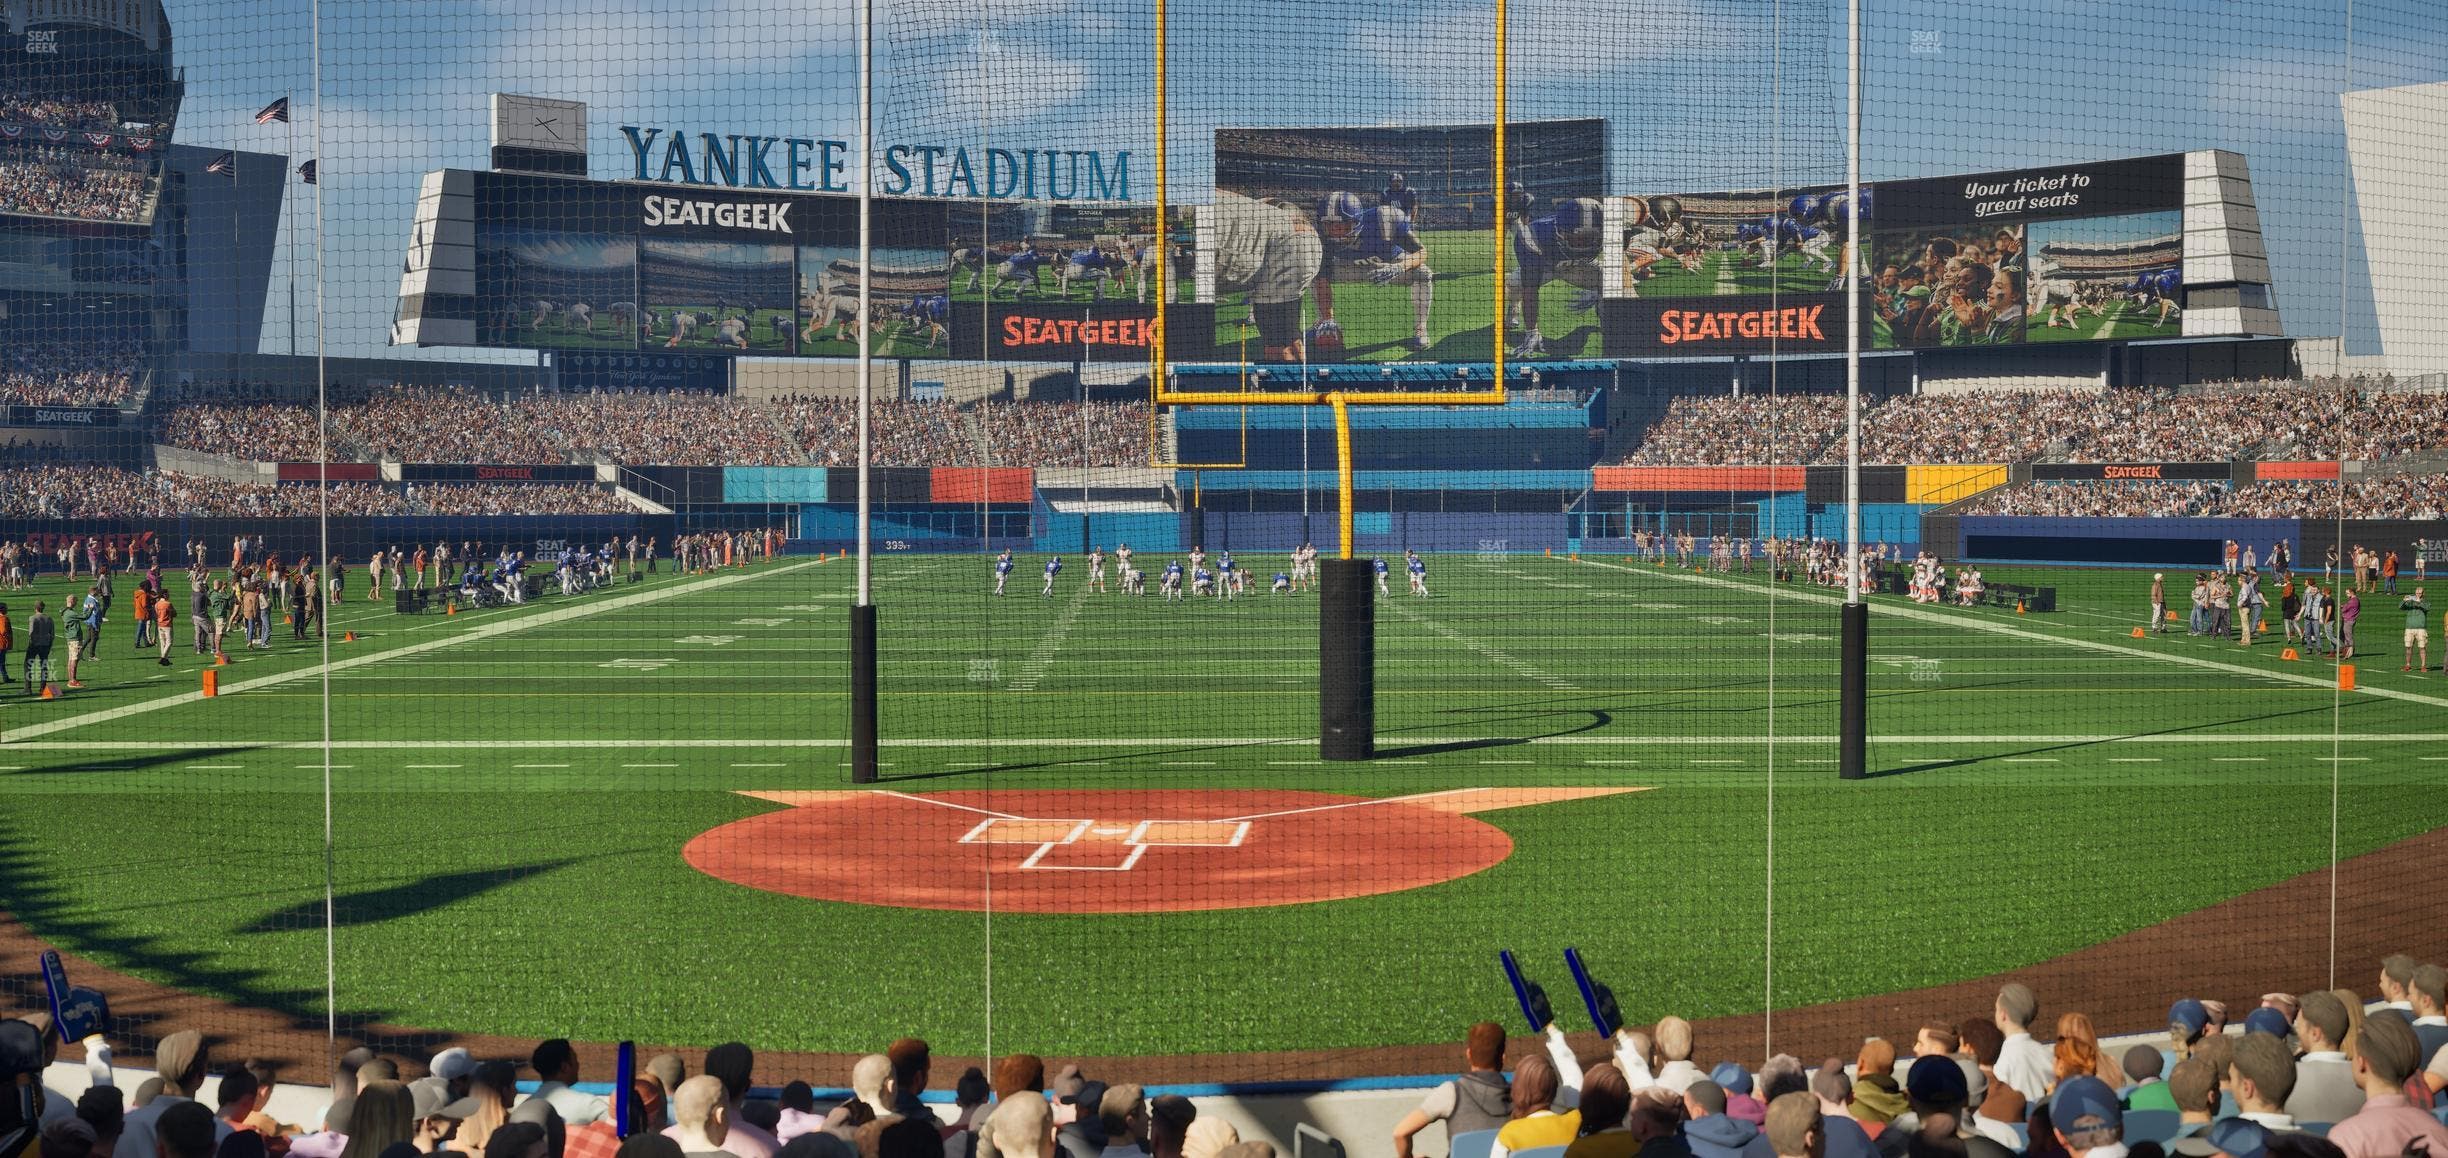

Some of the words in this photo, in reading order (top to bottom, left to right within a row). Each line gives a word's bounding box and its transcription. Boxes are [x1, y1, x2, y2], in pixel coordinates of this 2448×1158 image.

[620, 126, 848, 192] YANKEE
[883, 144, 1132, 200] STADIUM
[1964, 182, 2010, 199] Your
[2013, 174, 2069, 193] ticket
[2071, 173, 2091, 188] to
[644, 195, 793, 234] SEATGEEK
[1975, 195, 2027, 218] great
[2028, 191, 2080, 209] seats
[1003, 315, 1159, 347] SEATGEEK
[1660, 304, 1825, 344] SEATGEEK
[35, 409, 93, 424] SEATGEEK
[478, 466, 534, 479] SEATGEEK
[2104, 465, 2161, 479] SEATGEEK
